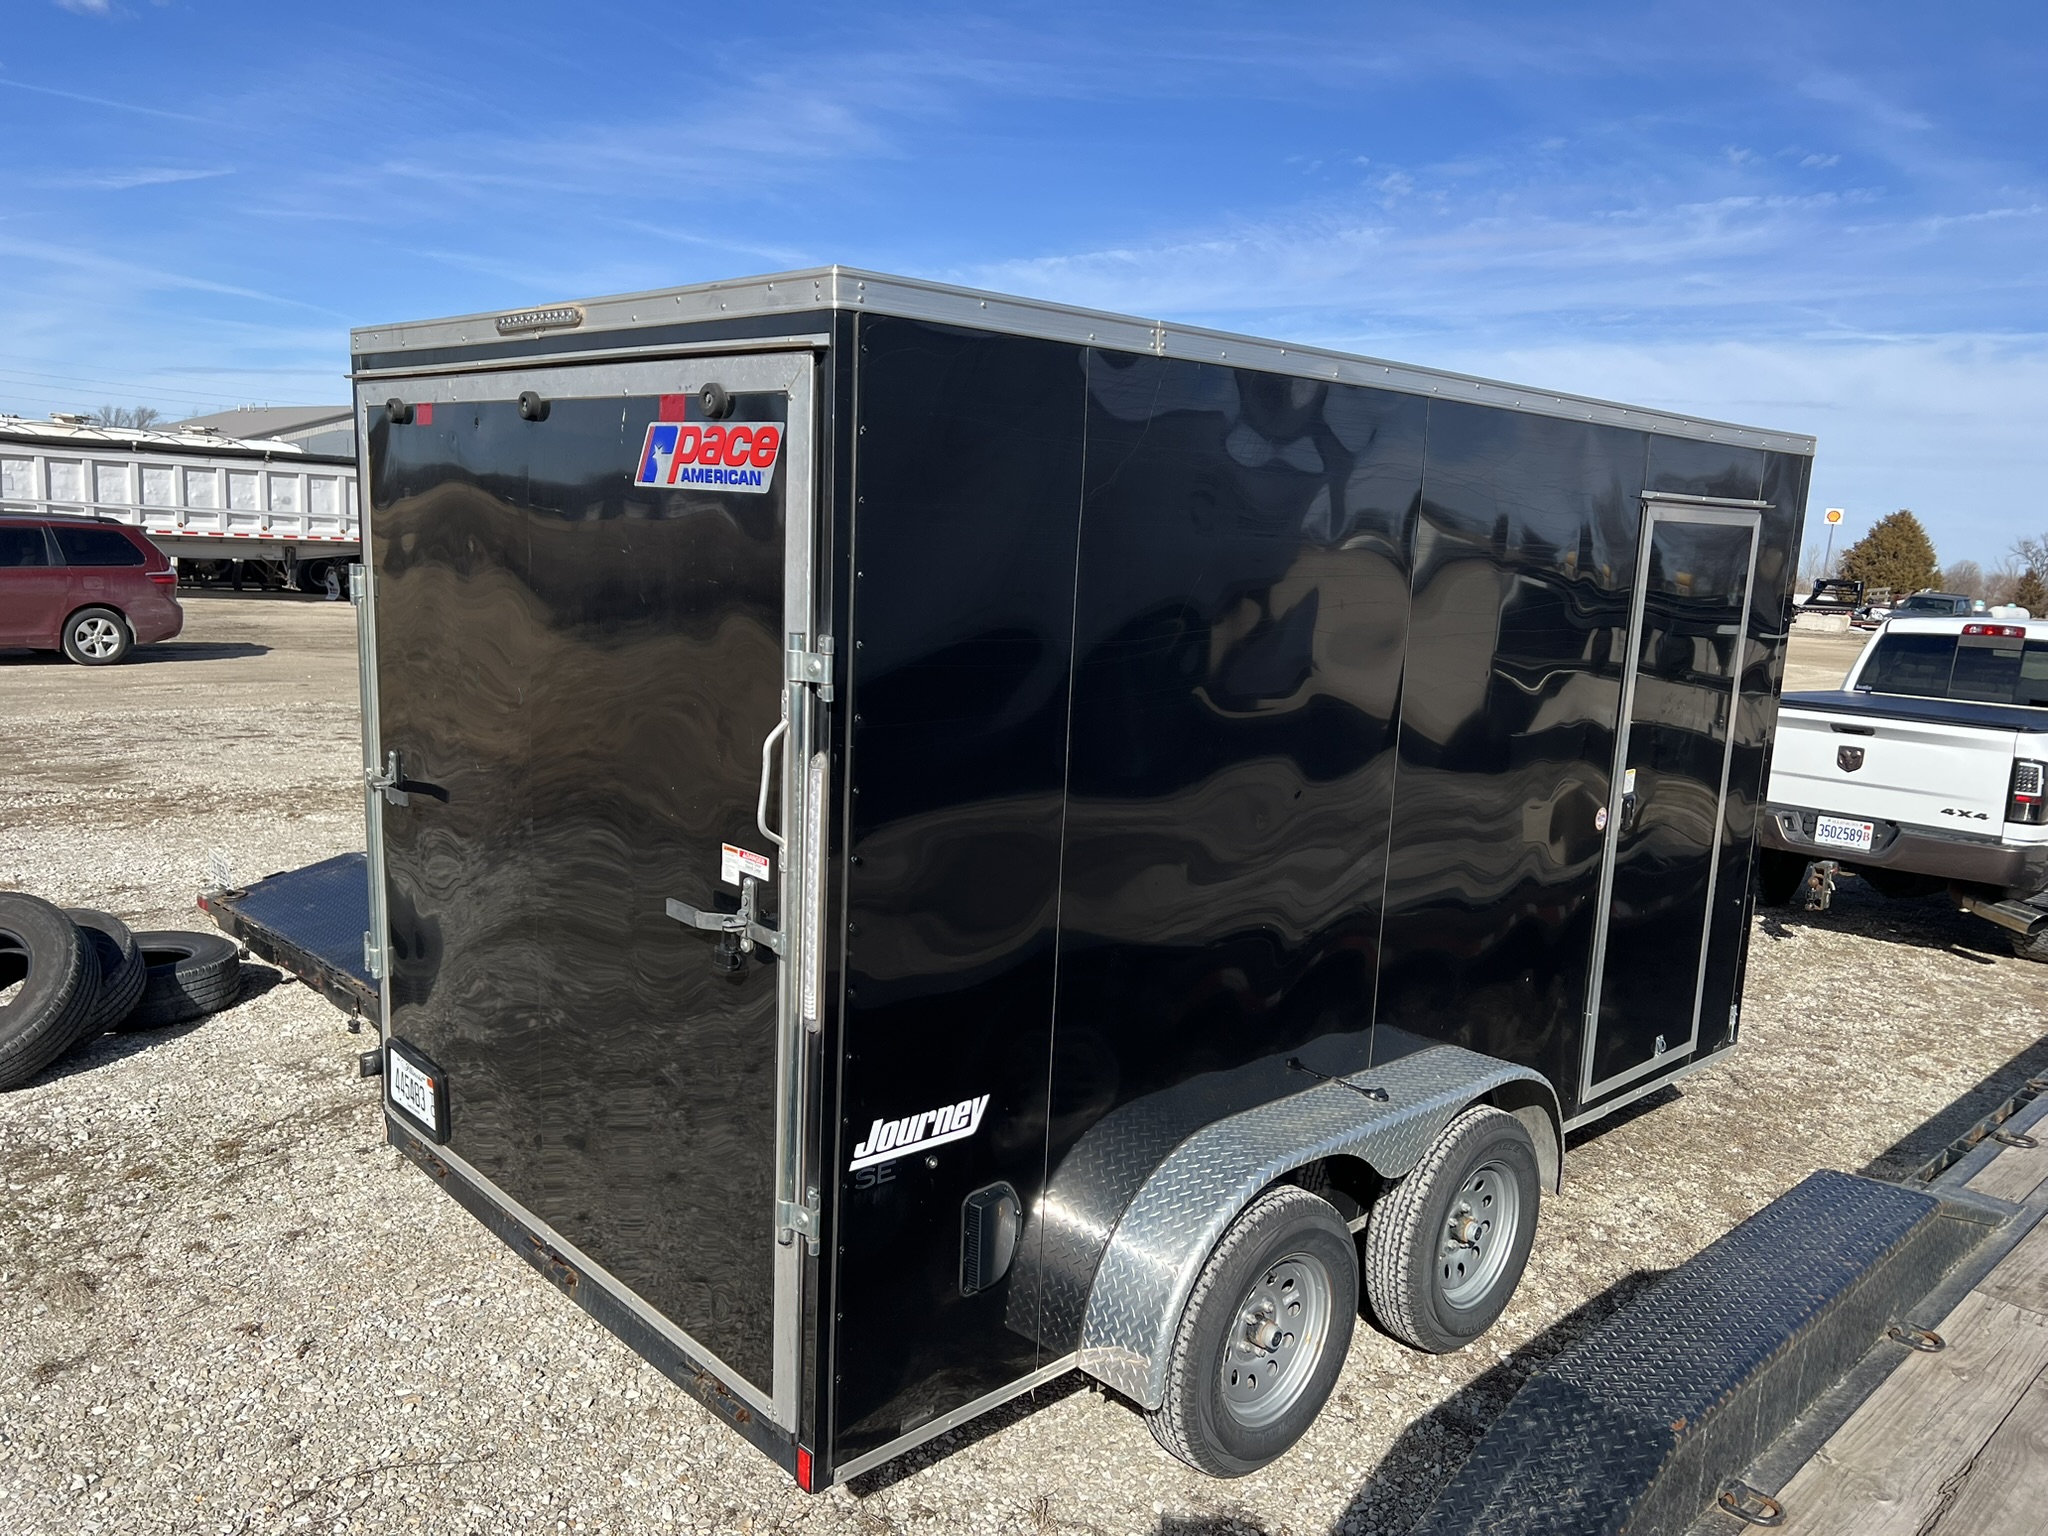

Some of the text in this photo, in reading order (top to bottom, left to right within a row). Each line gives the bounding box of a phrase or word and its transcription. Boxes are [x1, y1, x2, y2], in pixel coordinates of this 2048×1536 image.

[681, 467, 761, 486] AMERICAN
[1818, 823, 1863, 843] 3502589
[1863, 831, 1870, 842] B
[853, 1093, 990, 1159] Journey
[855, 1160, 897, 1190] SE
